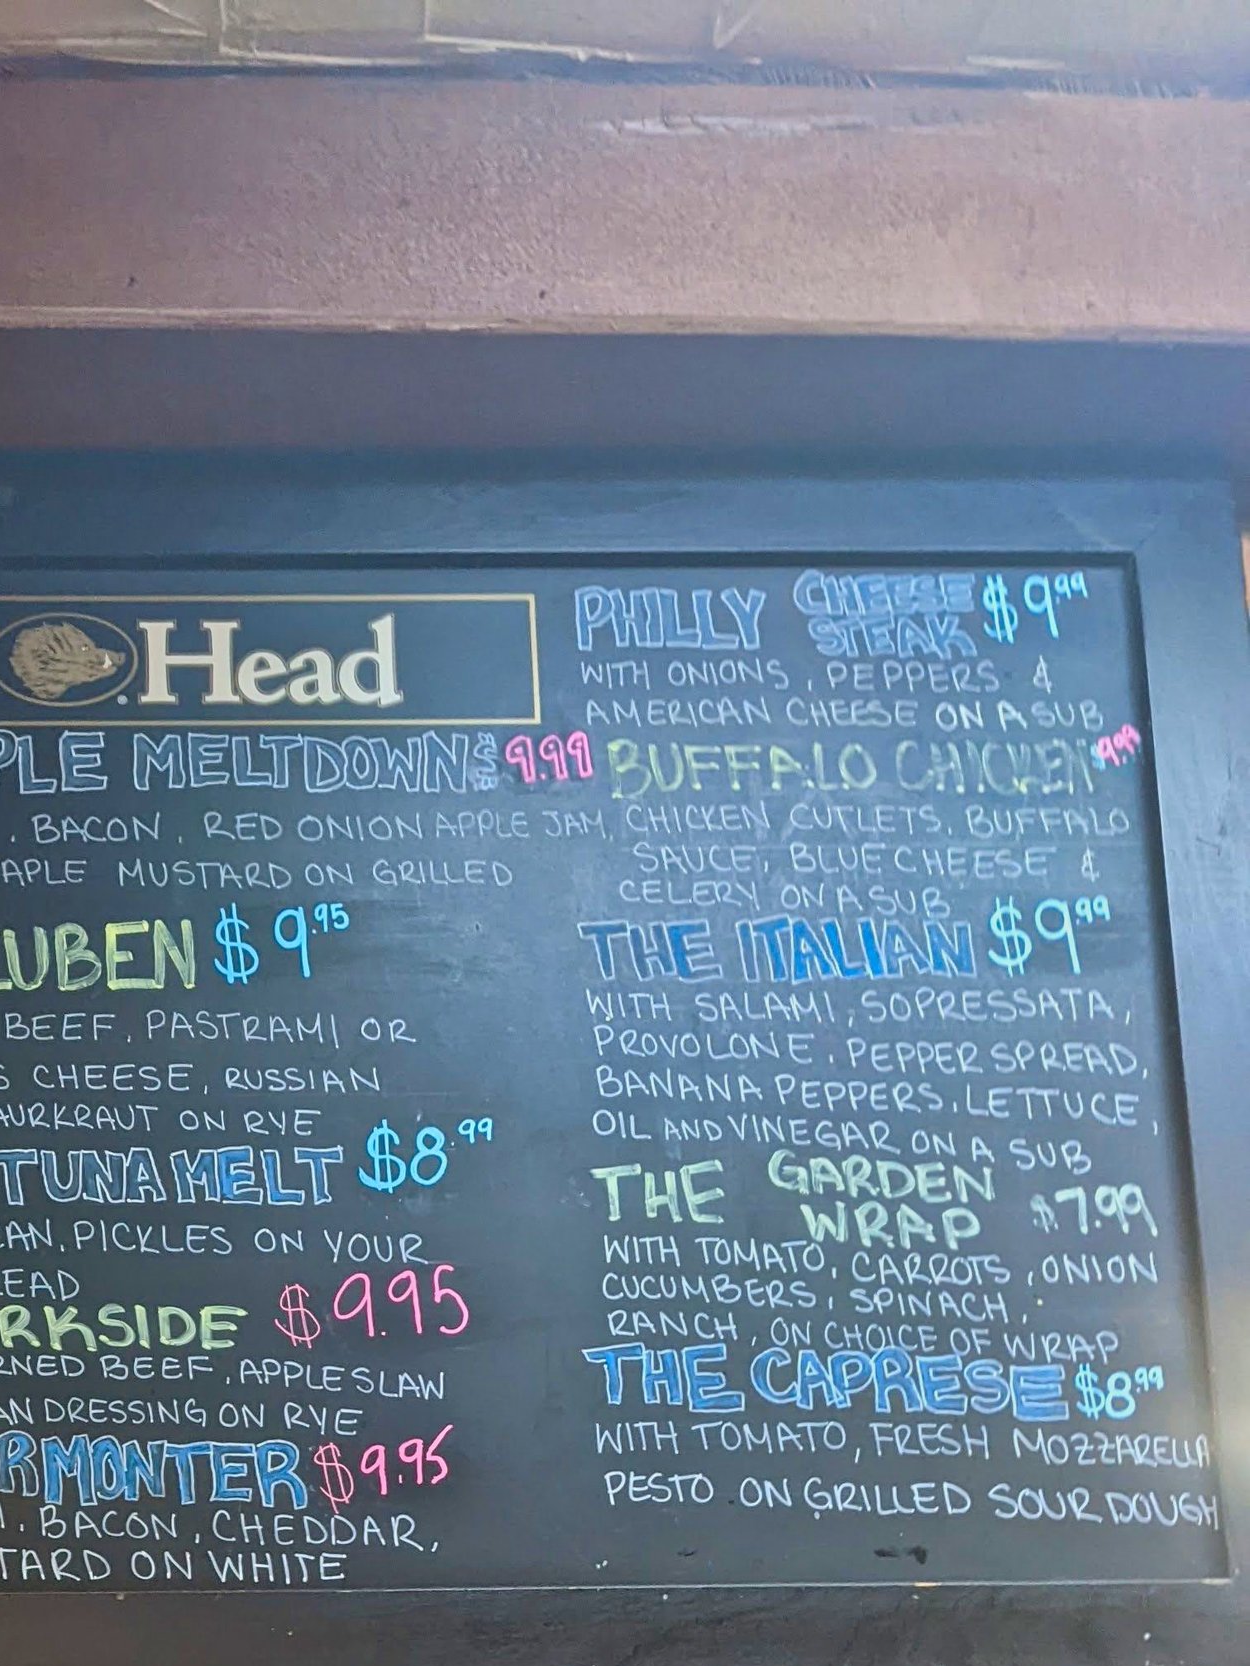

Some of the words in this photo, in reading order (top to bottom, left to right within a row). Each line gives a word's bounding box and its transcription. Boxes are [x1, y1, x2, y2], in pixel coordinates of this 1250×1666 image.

[574, 584, 767, 652] PHILLY
[793, 569, 976, 614] CHEESE
[807, 615, 977, 659] STEAK
[139, 613, 403, 708] Head
[586, 698, 770, 728] AMERICAN
[786, 701, 919, 728] CHEESE
[935, 702, 983, 729] ON
[998, 703, 1028, 730] A
[1030, 702, 1104, 732] SUB
[133, 731, 468, 794] MELTDOWN
[607, 738, 878, 800] BUFFALO
[895, 738, 1095, 795] CHICKEN
[118, 861, 292, 890] MUSTARD
[304, 861, 354, 887] ON
[372, 861, 513, 888] GRILLED
[619, 881, 758, 908] CELERY
[781, 885, 827, 912] ON
[837, 886, 864, 914] A
[868, 888, 951, 919] SUB
[578, 920, 723, 983] THE
[736, 915, 978, 984] ITALIAN
[179, 1109, 225, 1131] ON
[244, 1108, 321, 1136] RYE
[592, 1110, 651, 1140] OIL
[664, 1117, 721, 1142] AND
[728, 1115, 901, 1155] VINEGAR
[912, 1132, 956, 1157] ON
[972, 1136, 994, 1163] A
[1009, 1140, 1092, 1175] SUB
[170, 1145, 343, 1205] MELT
[591, 1161, 724, 1224] THE
[767, 1149, 996, 1204] GARDEN
[800, 1202, 982, 1251] WRAP
[582, 1343, 745, 1413] THE
[750, 1345, 1069, 1422] CAPRESE
[595, 1423, 677, 1455] WITH
[874, 1423, 989, 1459] FRESH
[605, 1470, 714, 1506] PESTO
[740, 1476, 794, 1509] ON
[804, 1477, 972, 1517] GRILLED
[988, 1483, 1102, 1523] SOUR
[1105, 1491, 1218, 1530] DOUGH
[131, 1551, 192, 1580] ON
[208, 1551, 347, 1584] WHITE
